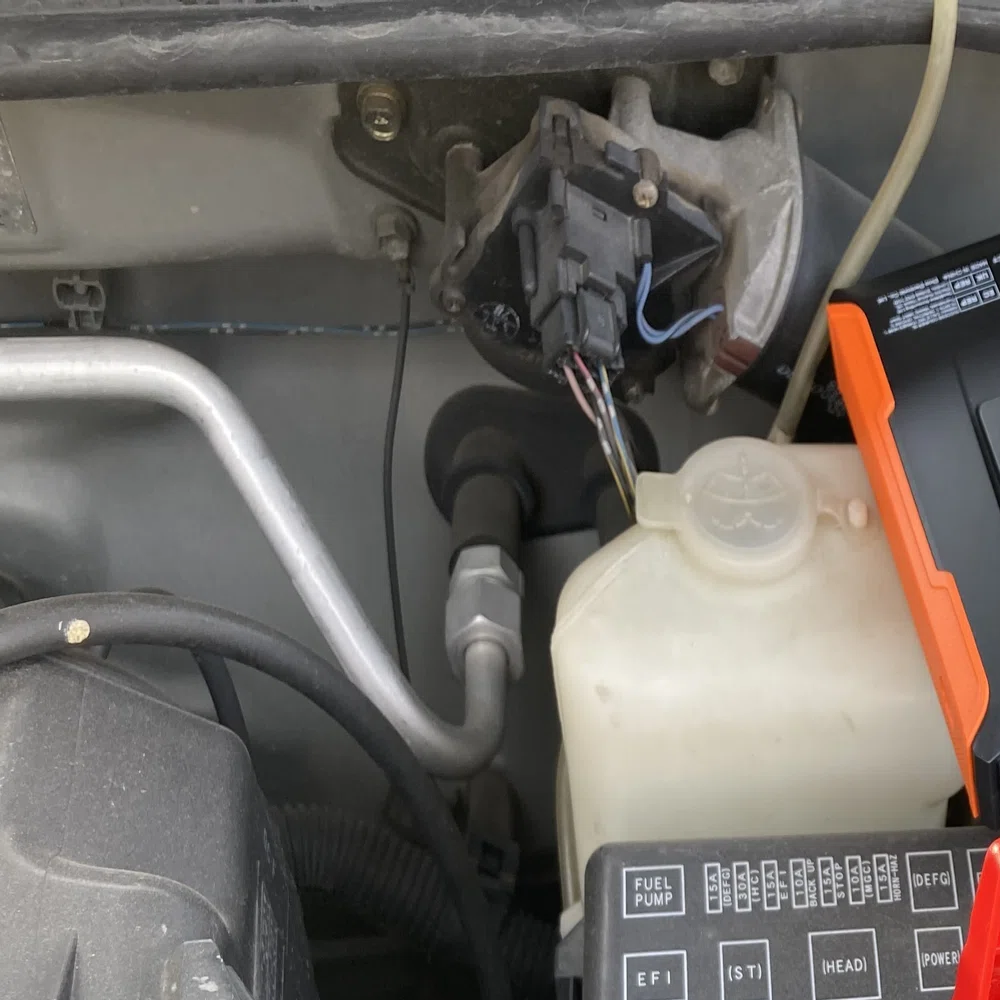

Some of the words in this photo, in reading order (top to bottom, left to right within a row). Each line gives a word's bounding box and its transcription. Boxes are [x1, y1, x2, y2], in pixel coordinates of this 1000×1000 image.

[806, 858, 815, 874] UP
[850, 864, 860, 893] 10A
[878, 863, 888, 891] 15A
[913, 871, 950, 888] (DEFG)
[635, 876, 672, 891] FUEL
[708, 873, 718, 901] 15A
[721, 867, 733, 907] (DEFG)
[737, 872, 747, 900] 30A
[750, 869, 761, 903] (HC)
[766, 869, 776, 898] 15A
[779, 870, 789, 900] EFI
[794, 868, 805, 896] 10A
[808, 878, 818, 907] BACK
[823, 866, 833, 895] 15A
[834, 862, 846, 899] STOP
[635, 892, 673, 907] PUMP
[728, 963, 762, 982] (ST)
[822, 956, 867, 975] (HEAD)
[921, 950, 960, 967] (POWER)
[638, 970, 671, 987] EFI
